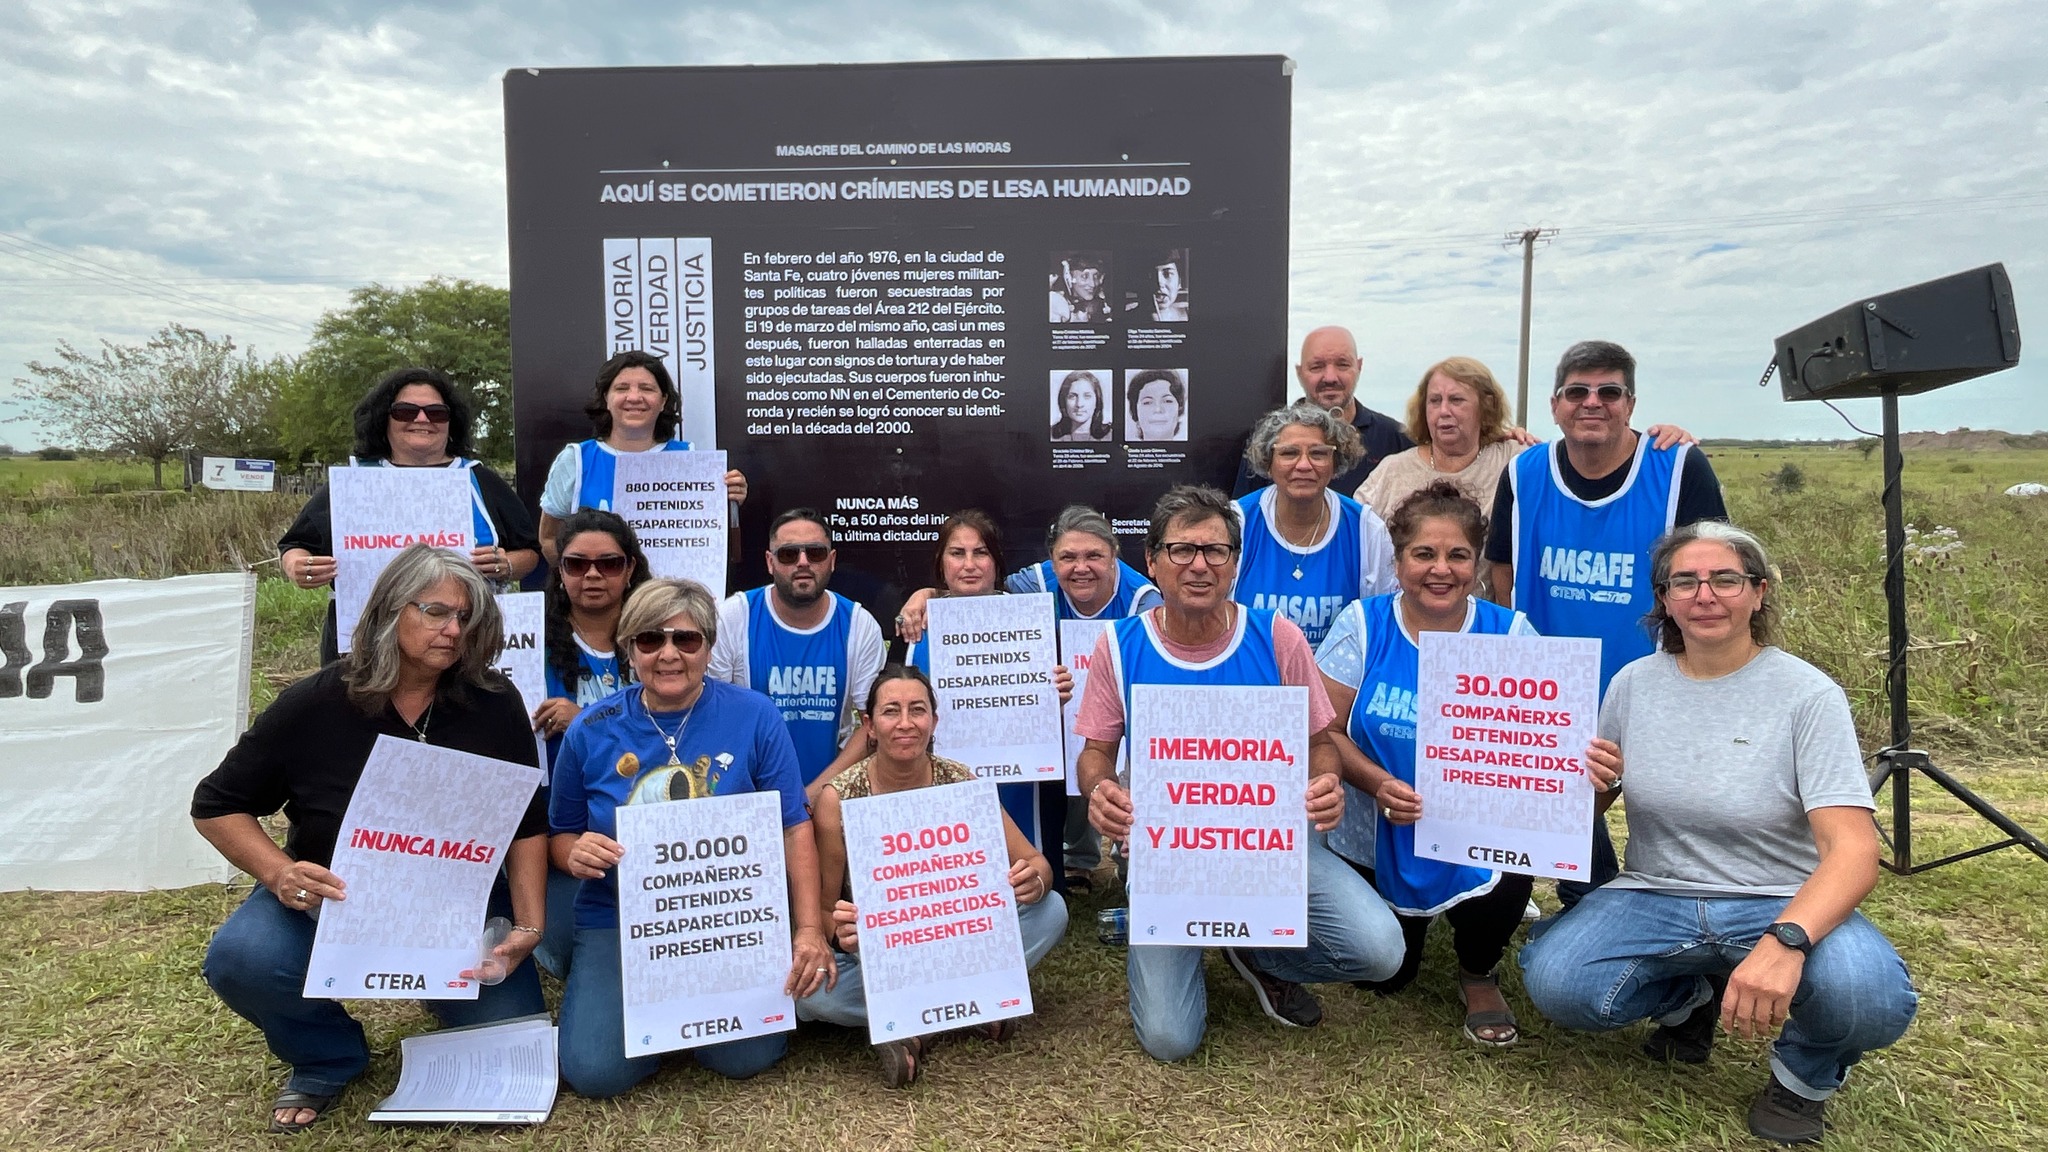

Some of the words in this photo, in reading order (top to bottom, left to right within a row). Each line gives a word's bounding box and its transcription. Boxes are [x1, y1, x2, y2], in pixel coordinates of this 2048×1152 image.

[775, 144, 838, 156] MASACRE
[839, 143, 865, 155] DEL
[865, 142, 917, 155] CAMINO
[918, 142, 937, 154] DE
[937, 141, 963, 154] LAS
[963, 141, 1011, 153] MORAS
[599, 179, 654, 203] AQUÍ
[658, 182, 687, 202] SE
[690, 181, 837, 202] COMETIERON
[840, 176, 954, 200] CRÍMENES
[957, 179, 989, 198] DE
[992, 178, 1049, 198] LESA
[1053, 176, 1191, 198] HUMANIDAD
[743, 251, 760, 265] En
[763, 251, 812, 264] febrero
[815, 251, 836, 264] del
[839, 251, 864, 264] año
[867, 250, 901, 265] 1976,
[903, 253, 921, 263] en
[924, 250, 937, 263] la
[939, 250, 983, 263] ciudad
[986, 250, 1005, 263] de
[743, 268, 781, 282] Santa
[783, 268, 804, 283] Fe,
[806, 269, 848, 281] cuatro
[850, 267, 900, 284] jóvenes
[903, 267, 955, 283] mujeres
[957, 267, 1005, 280] militan-
[743, 286, 764, 299] tes
[773, 285, 827, 301] políticas
[835, 285, 878, 298] fueron
[887, 284, 973, 298] secuestradas
[981, 287, 1005, 300] por
[613, 254, 634, 351] EMORIA
[648, 255, 669, 359] VERDAD
[744, 305, 790, 319] grupos
[791, 303, 809, 315] de
[810, 303, 851, 315] tareas
[852, 302, 872, 315] del
[874, 300, 906, 315] Área
[907, 301, 930, 315] 212
[931, 302, 952, 314] del
[953, 301, 1005, 317] Ejército.
[684, 254, 706, 371] JUSTICIA
[744, 320, 757, 333] El
[758, 320, 773, 333] 19
[775, 320, 792, 333] de
[794, 322, 835, 333] marzo
[836, 319, 857, 332] del
[858, 319, 901, 332] mismo
[902, 319, 930, 333] año,
[931, 319, 957, 332] casi
[959, 321, 975, 331] un
[977, 321, 1005, 331] mes
[744, 336, 802, 352] después,
[807, 337, 850, 349] fueron
[855, 336, 908, 349] halladas
[913, 336, 983, 349] enterradas
[988, 338, 1005, 348] en
[745, 354, 773, 367] este
[774, 354, 807, 369] lugar
[808, 356, 832, 367] con
[833, 354, 876, 369] signos
[876, 353, 894, 366] de
[894, 354, 939, 366] tortura
[939, 356, 948, 368] y
[949, 353, 966, 365] de
[967, 353, 1005, 365] haber
[745, 371, 773, 384] sido
[774, 370, 846, 386] ejecutadas.
[848, 370, 873, 383] Sus
[874, 372, 927, 386] cuerpos
[928, 370, 971, 383] fueron
[972, 370, 1005, 382] inhu-
[746, 388, 789, 401] mados
[791, 390, 828, 401] como
[829, 387, 850, 400] NN
[852, 390, 869, 400] en
[871, 387, 883, 400] el
[885, 387, 960, 400] Cementerio
[961, 386, 979, 399] de
[981, 386, 1005, 399] Co-
[746, 405, 784, 418] ronda
[785, 407, 794, 420] y
[797, 404, 836, 417] recién
[838, 407, 854, 417] se
[856, 404, 890, 420] logró
[892, 406, 945, 417] conocer
[946, 406, 963, 416] su
[965, 403, 1005, 416] identi-
[746, 422, 771, 435] dad
[773, 424, 790, 434] en
[791, 421, 803, 434] la
[804, 421, 853, 434] década
[853, 421, 874, 434] del
[875, 421, 914, 434] 2000.
[215, 465, 224, 476] 7
[625, 482, 650, 493] 880
[652, 481, 715, 492] DOCENTES
[636, 500, 704, 511] DETENIDXS
[836, 497, 886, 510] NUNCA
[887, 494, 919, 510] MÁS
[627, 518, 721, 531] ESAPARECIDXS,
[830, 513, 849, 527] Fe,
[850, 516, 859, 526] a
[860, 513, 877, 526] 50
[878, 513, 909, 526] años
[909, 513, 929, 525] del
[344, 534, 414, 550] ¡NUNCA
[418, 530, 465, 547] MÁS!
[639, 537, 709, 548] PRESENTES!
[831, 529, 843, 542] la
[844, 529, 881, 542] última
[882, 529, 939, 541] dictadura
[1540, 546, 1634, 587] AMSAFE
[1550, 585, 1586, 601] CTERA
[941, 633, 969, 646] 880
[971, 628, 1042, 644] DOCENTES
[955, 650, 1031, 666] DETENIDXS
[937, 670, 1052, 689] DESAPARECIDXS,
[1454, 674, 1558, 701] 30.000
[951, 693, 1039, 710] ¡PRESENTES!
[1440, 703, 1571, 727] COMPAÑERXS
[1452, 725, 1558, 748] DETENIDXS
[1149, 737, 1294, 766] ¡MEMORIA,
[1425, 744, 1588, 776] DESAPARECIDXS,
[975, 763, 1022, 778] CTERA
[1442, 768, 1564, 794] ¡PRESENTES!
[1165, 782, 1276, 806] VERDAD
[350, 828, 435, 857] ¡NUNCA
[437, 838, 496, 864] MÁS!
[879, 822, 970, 856] 30.000
[1145, 826, 1166, 849] Y
[1169, 826, 1293, 851] JUSTICIA!
[653, 834, 747, 864] 30.000
[1467, 845, 1532, 867] CTERA
[872, 849, 986, 882] COMPAÑERXS
[642, 863, 762, 891] COMPAÑERXS
[885, 873, 979, 903] DETENIDXS
[655, 886, 753, 913] DETENIDXS
[865, 891, 1006, 929] DESAPARECIDXS,
[630, 906, 779, 940] DESAPARECIDXS,
[884, 915, 993, 949] ¡PRESENTES!
[1186, 921, 1250, 938] CTERA
[649, 930, 763, 961] ¡PRESENTES!
[364, 972, 426, 990] CTERA
[921, 1000, 981, 1025] CTERA
[680, 1015, 743, 1039] CTERA
